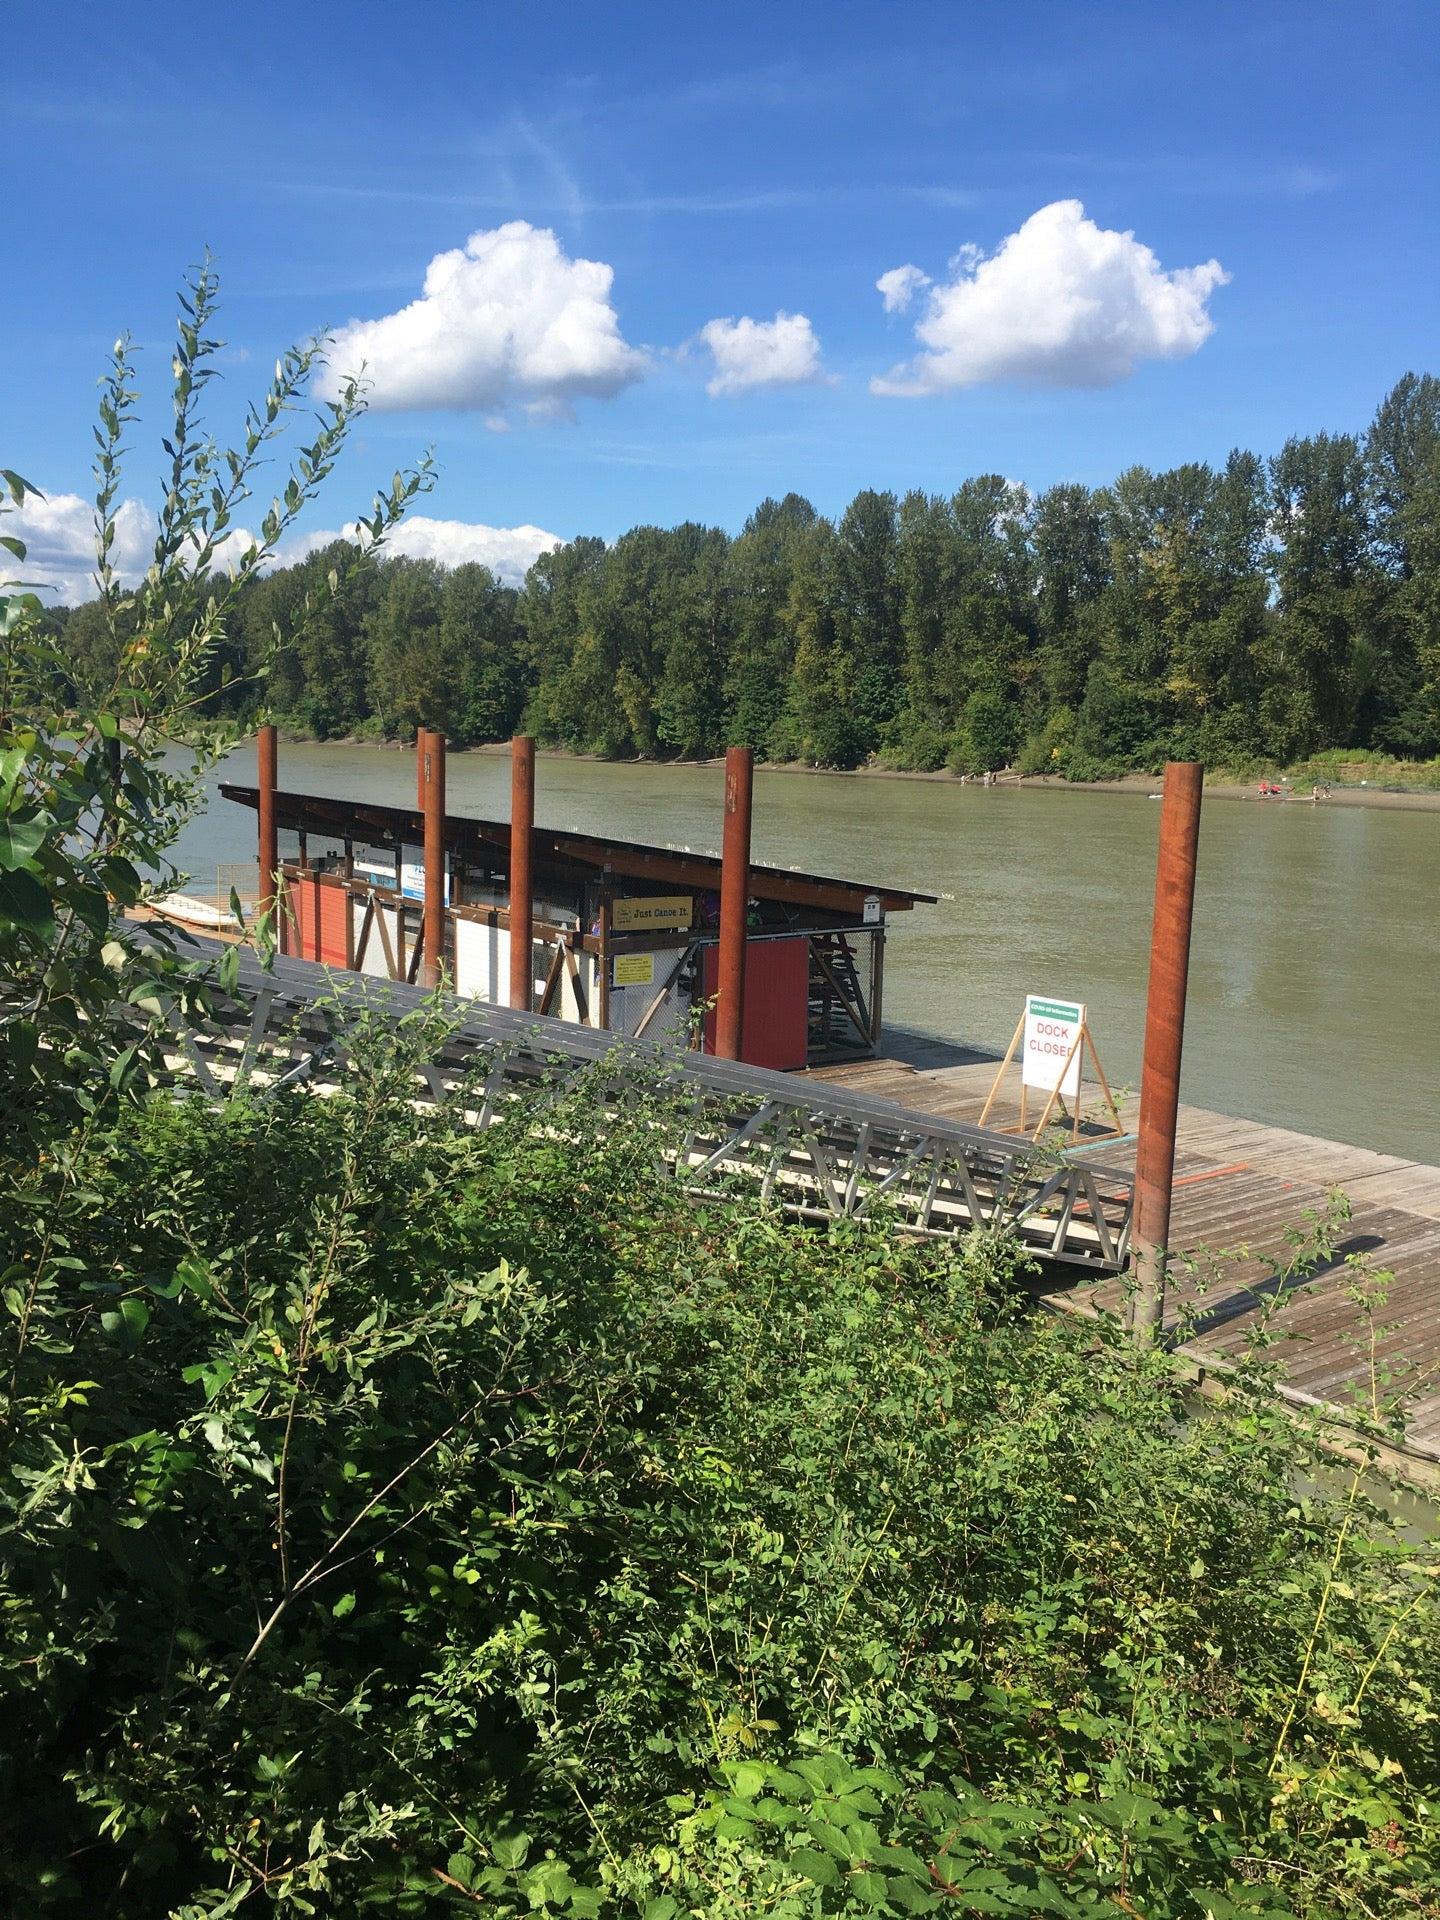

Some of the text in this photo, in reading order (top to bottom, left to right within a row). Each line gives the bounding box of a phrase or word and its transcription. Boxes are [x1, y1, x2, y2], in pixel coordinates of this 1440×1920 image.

[634, 909, 652, 918] Just
[655, 908, 677, 917] Canoe
[679, 907, 688, 916] It.
[1037, 1022, 1069, 1039] DOCK
